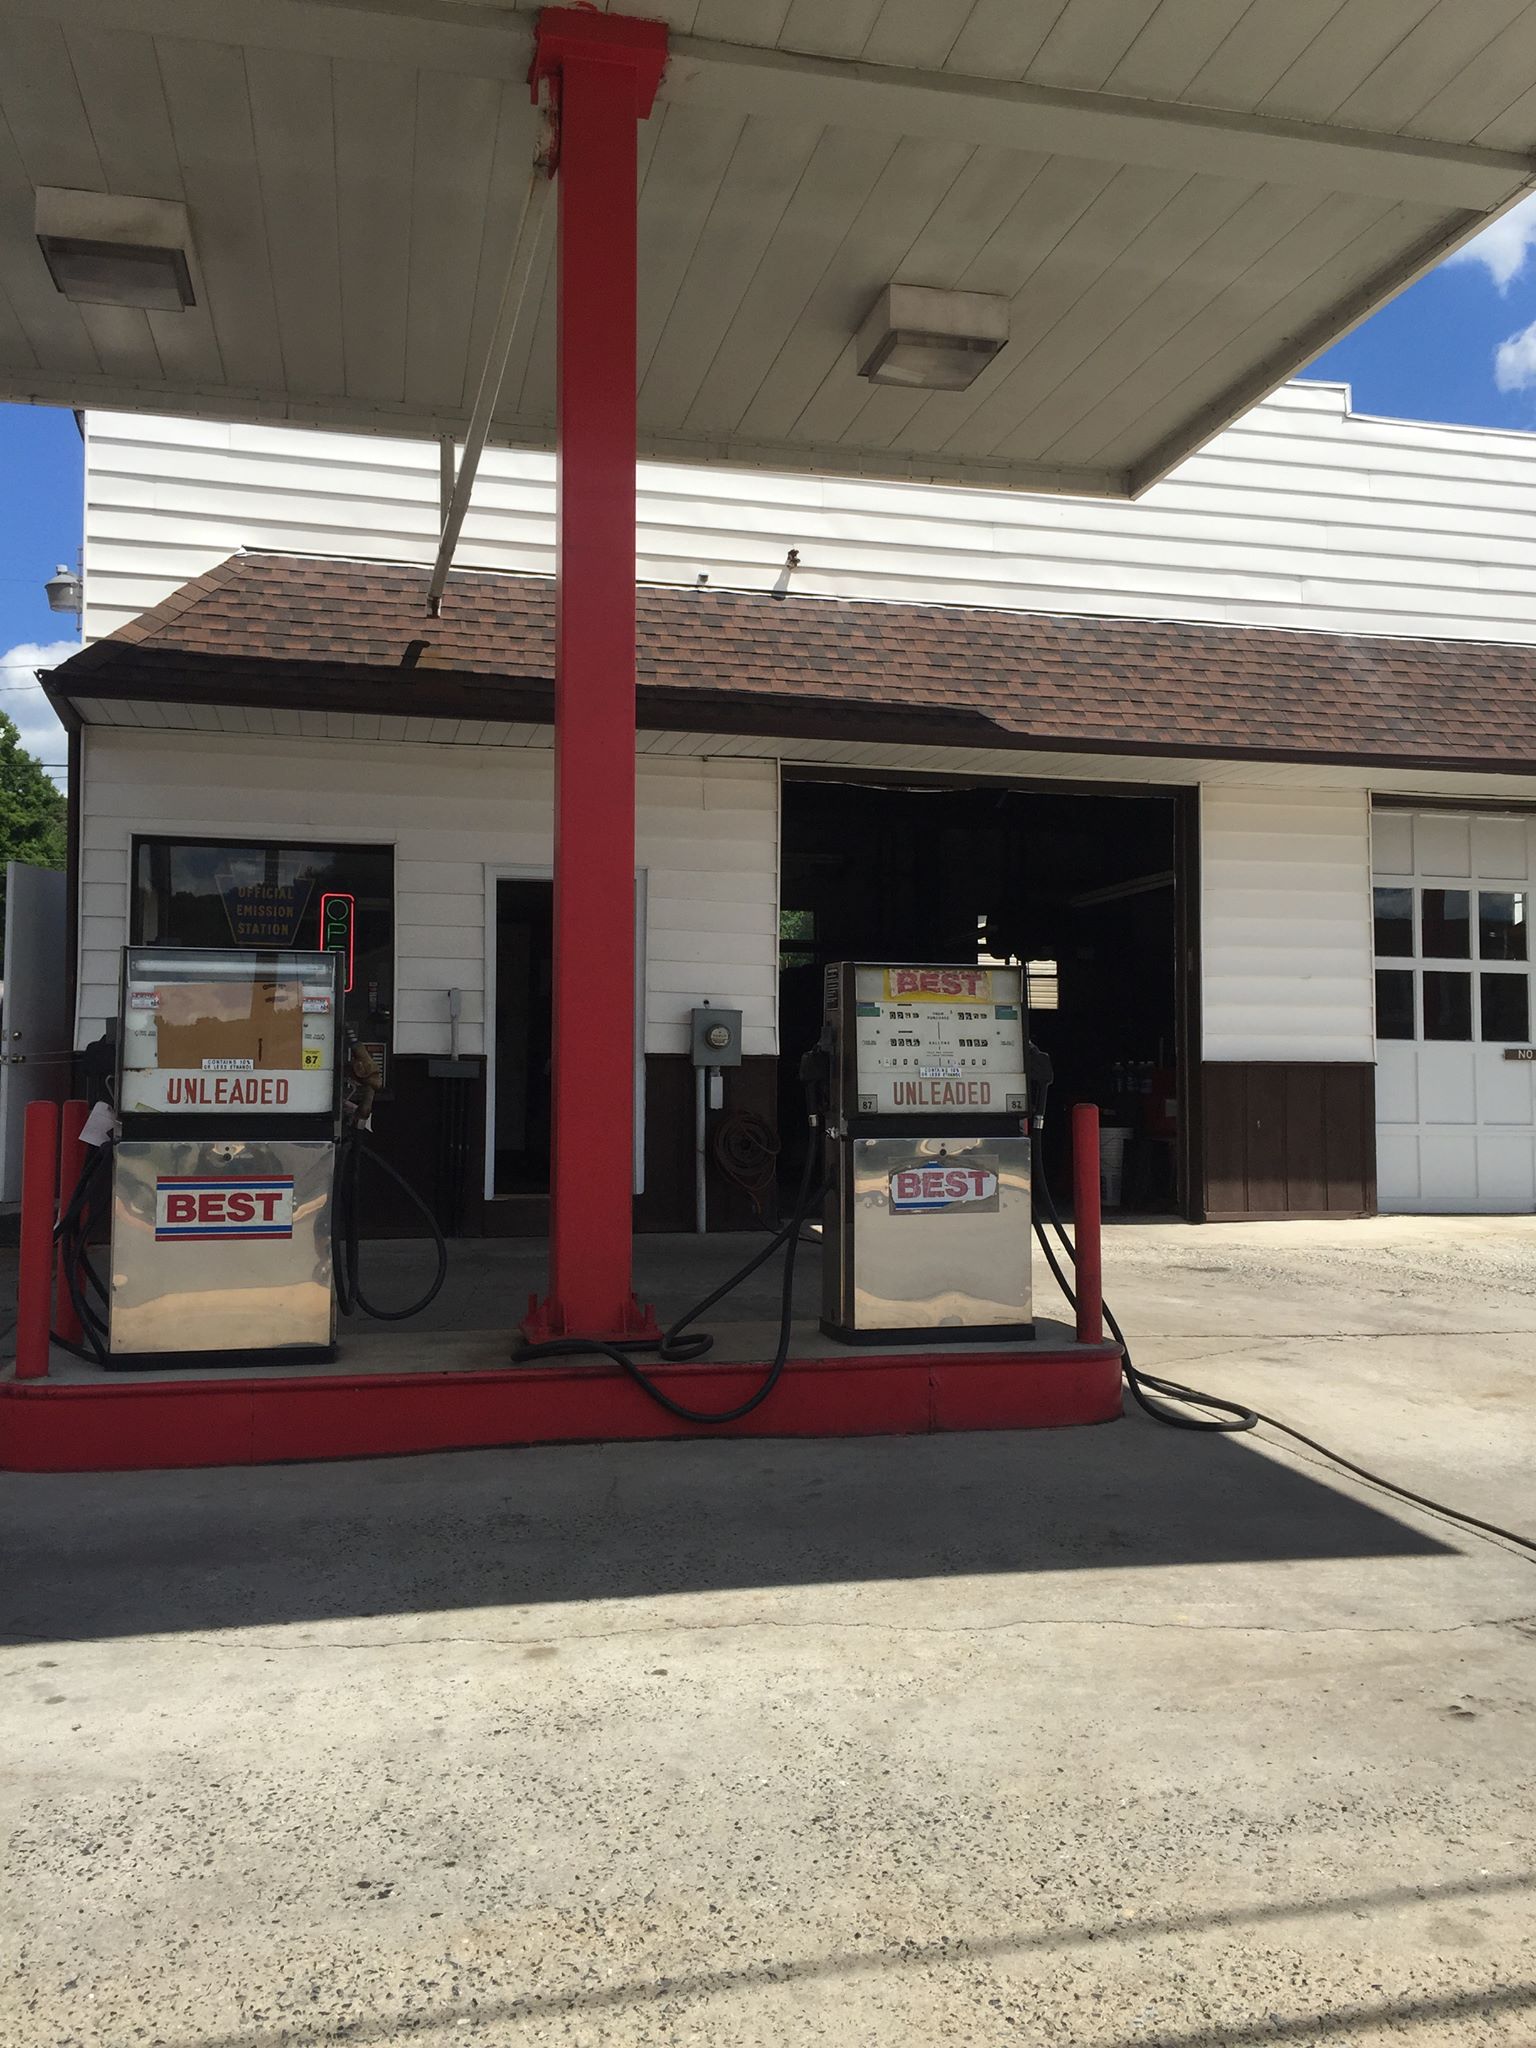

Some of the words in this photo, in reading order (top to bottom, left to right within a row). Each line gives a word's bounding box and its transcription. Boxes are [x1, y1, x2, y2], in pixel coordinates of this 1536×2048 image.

[238, 886, 294, 900] OFFICIAL
[237, 904, 294, 918] EMISSION
[237, 922, 289, 935] STATION
[896, 969, 983, 996] BEST
[304, 1055, 318, 1065] 87
[1518, 1049, 1533, 1059] NO
[166, 1078, 289, 1105] UNLEADED
[893, 1081, 991, 1105] UNLEADED
[862, 1100, 873, 1110] 87
[897, 1170, 990, 1199] BEST
[166, 1193, 283, 1223] BEST
